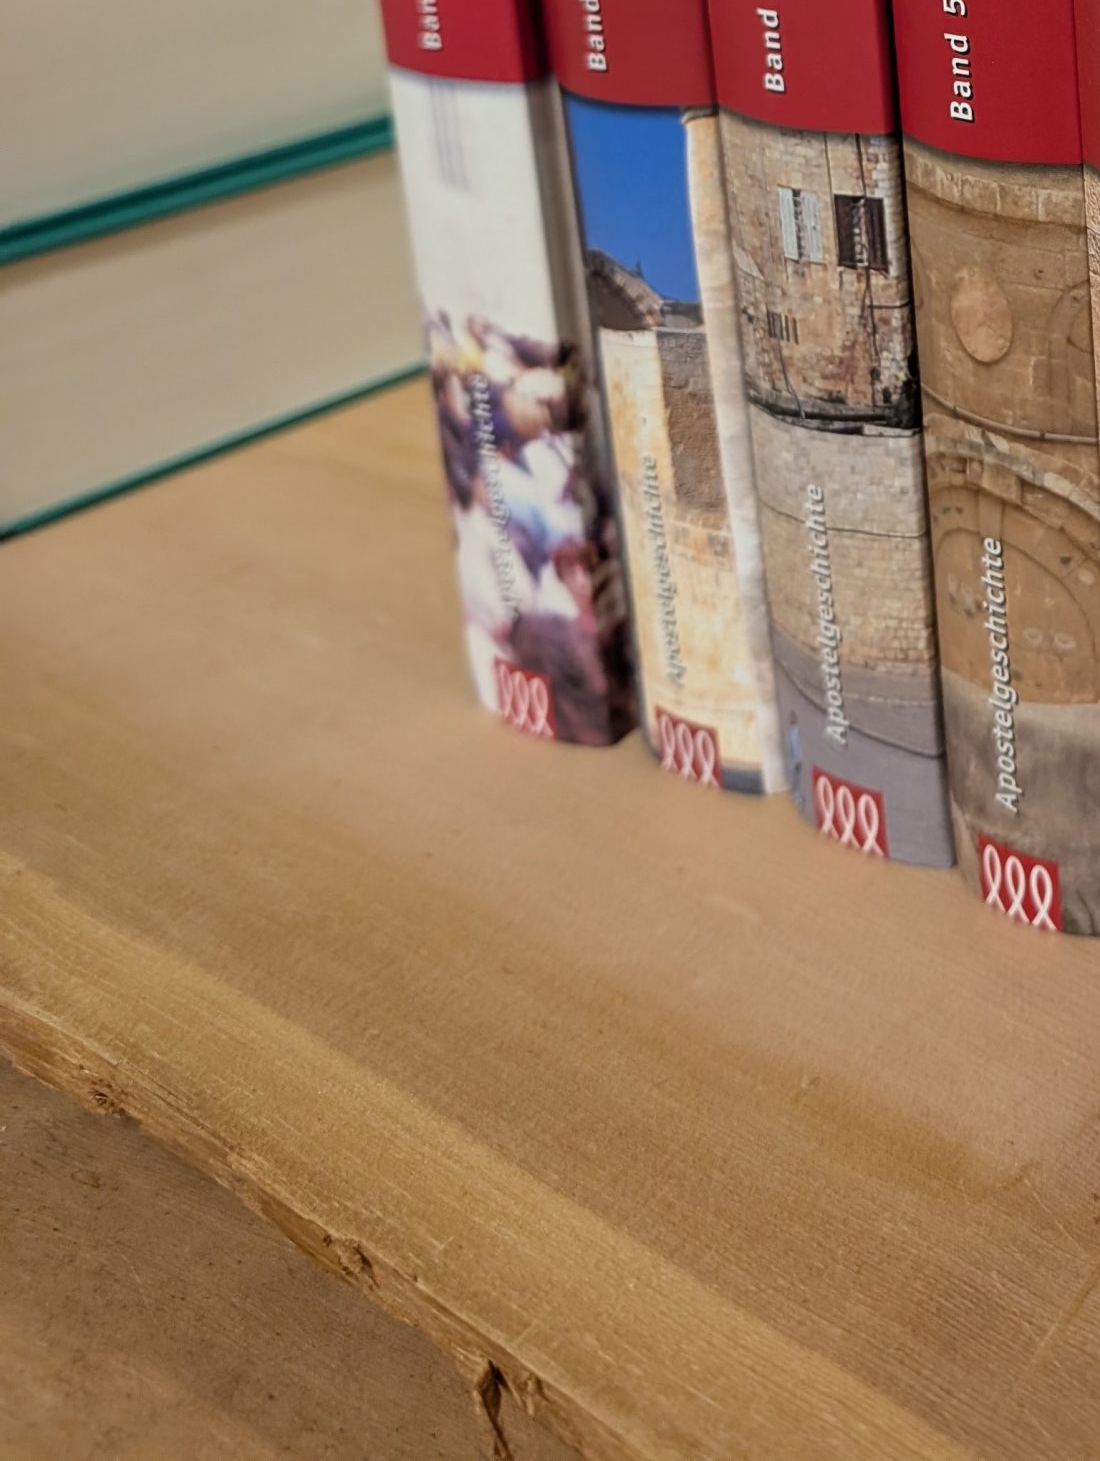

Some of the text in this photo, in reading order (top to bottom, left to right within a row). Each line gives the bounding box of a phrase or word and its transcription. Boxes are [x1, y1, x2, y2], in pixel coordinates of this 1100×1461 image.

[756, 7, 785, 94] Band
[943, 32, 974, 124] Band
[806, 483, 848, 747] Apostelgeschichte
[981, 536, 1020, 815] Apostelgeschichte
